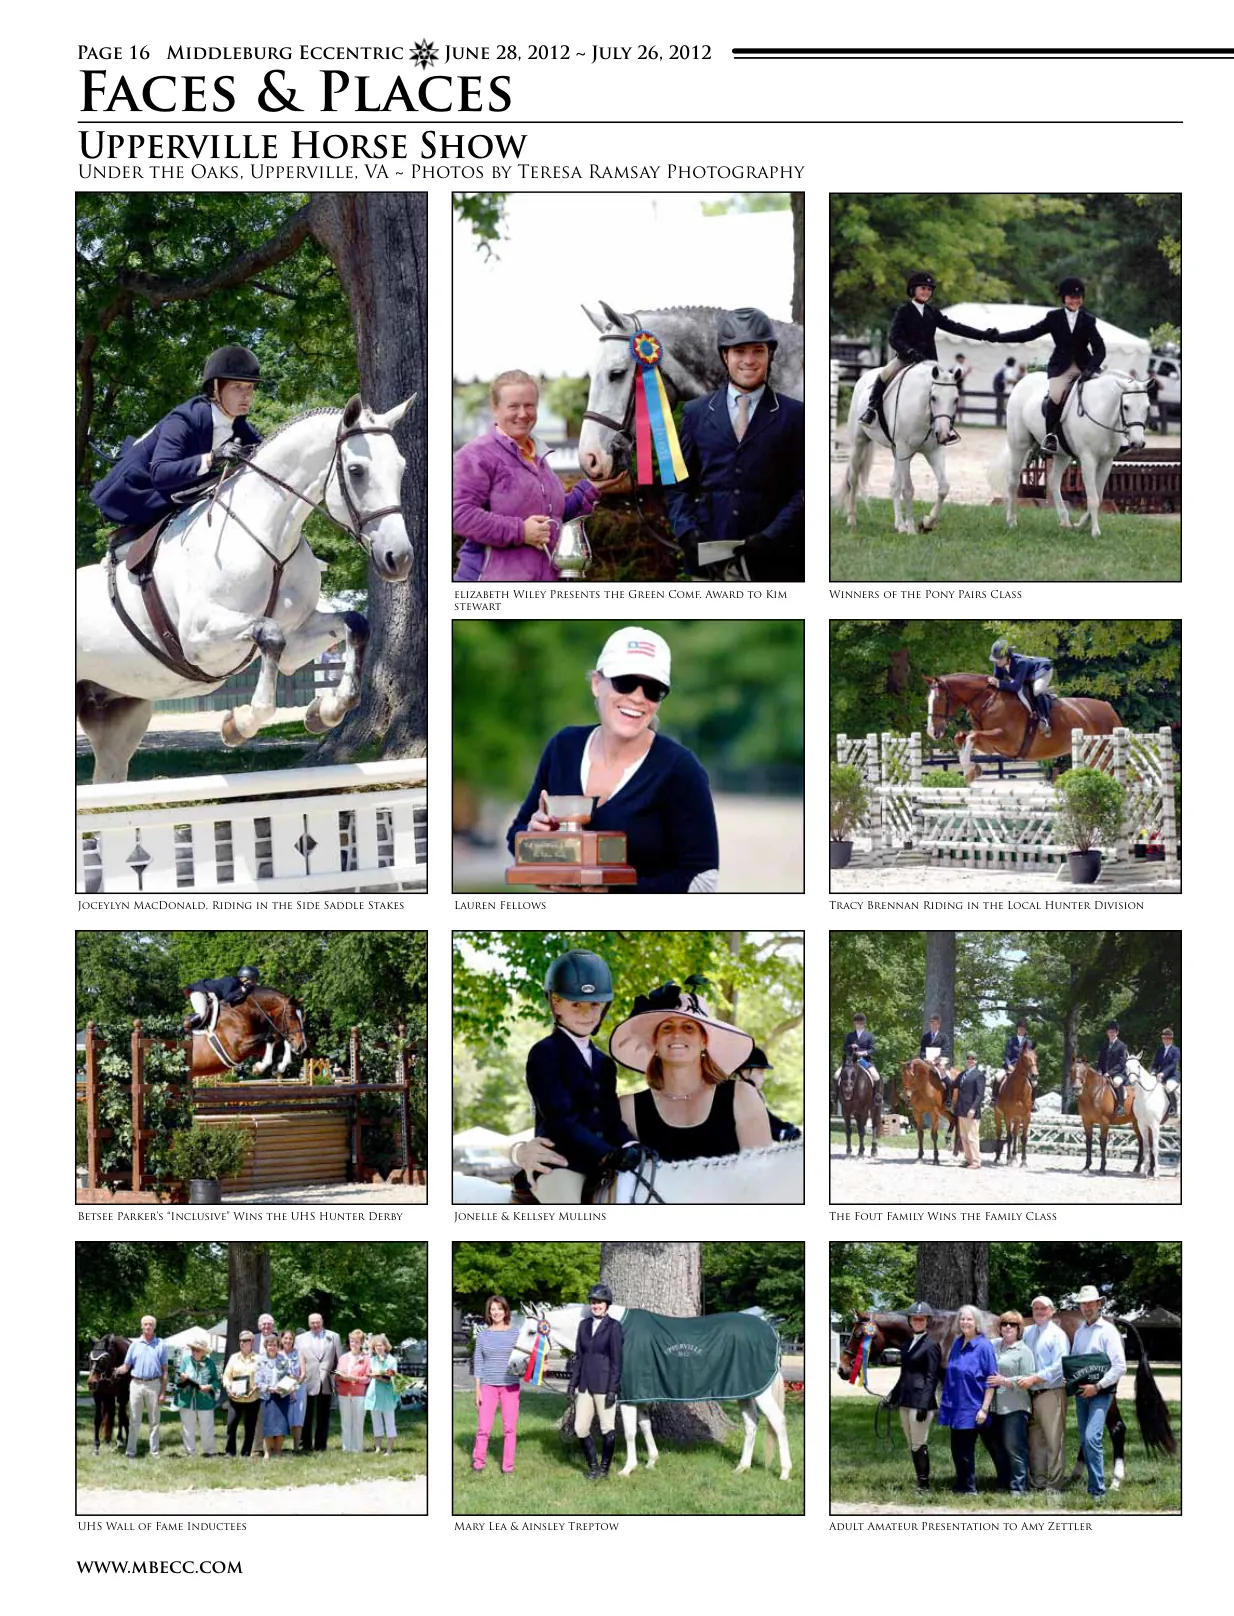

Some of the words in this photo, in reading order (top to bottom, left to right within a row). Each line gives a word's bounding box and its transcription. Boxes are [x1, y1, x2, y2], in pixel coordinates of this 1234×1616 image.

[78, 44, 123, 60] PAGE
[130, 44, 150, 60] 16
[166, 44, 293, 60] MIDDLEBURG
[299, 44, 404, 60] ECCENTRIC
[445, 44, 490, 64] JUNE
[496, 44, 522, 61] 28,
[527, 44, 571, 60] 2012
[591, 44, 633, 64] JULY
[637, 44, 663, 62] 26,
[668, 44, 712, 60] 2012
[79, 69, 236, 113] FACES
[319, 69, 512, 113] PLACES
[77, 130, 278, 160] UPPERVILLE
[290, 130, 408, 160] HORSE
[420, 130, 528, 160] SHOW
[78, 163, 144, 179] UNDER
[148, 165, 184, 179] THE
[191, 163, 244, 180] OAKS,
[250, 163, 358, 180] UPPERVILLE,
[364, 163, 389, 179] VA
[411, 163, 484, 179] PHOTOS
[492, 165, 512, 179] BY
[517, 163, 583, 179] TERESA
[589, 163, 661, 179] RAMSAY
[667, 163, 805, 179] PHOTOGRAPHY
[829, 589, 880, 599] WINNERS
[883, 590, 897, 599] OF
[900, 590, 921, 599] THE
[925, 589, 955, 599] PONY
[958, 589, 987, 599] PAIRS
[990, 589, 1022, 599] CLASS
[78, 900, 130, 911] JOCEYLYN
[133, 900, 208, 910] MACDONALD,
[212, 900, 252, 910] RIDING
[256, 901, 268, 910] IN
[271, 901, 293, 910] THE
[296, 900, 320, 910] SIDE
[324, 900, 364, 910] SADDLE
[368, 900, 405, 910] STAKES
[455, 900, 496, 910] LAUREN
[500, 900, 547, 910] FELLOWS
[828, 900, 864, 910] TRACY
[867, 900, 919, 910] BRENNAN
[923, 900, 963, 910] RIDING
[967, 901, 979, 910] IN
[982, 901, 1004, 910] THE
[1008, 900, 1042, 910] LOCAL
[1045, 900, 1091, 910] HUNTER
[1094, 900, 1144, 910] DIVISION
[454, 1211, 498, 1223] JONELLE
[513, 1211, 555, 1221] KELLSEY
[558, 1211, 607, 1221] MULLINS
[828, 1211, 851, 1221] THE
[855, 1211, 883, 1221] FOUT
[887, 1211, 924, 1221] FAMILY
[927, 1211, 957, 1221] WINS
[960, 1212, 981, 1221] THE
[985, 1211, 1023, 1221] FAMILY
[1025, 1211, 1057, 1221] CLASS
[78, 1521, 103, 1531] UHS
[105, 1521, 135, 1531] WALL
[138, 1522, 152, 1531] OF
[156, 1521, 183, 1531] FAME
[187, 1521, 247, 1531] INDUCTEES
[454, 1521, 486, 1531] MARY
[489, 1521, 508, 1531] LEA
[521, 1521, 565, 1531] AINSLEY
[567, 1521, 619, 1531] TREPTOW
[828, 1521, 865, 1531] ADULT
[867, 1522, 919, 1531] AMATEUR
[922, 1521, 999, 1531] PRESENTATION
[1002, 1522, 1018, 1531] TO
[1020, 1521, 1045, 1531] AMY
[1047, 1521, 1093, 1531] ZETTLER
[76, 1560, 243, 1574] WWW.MBECC.COM
